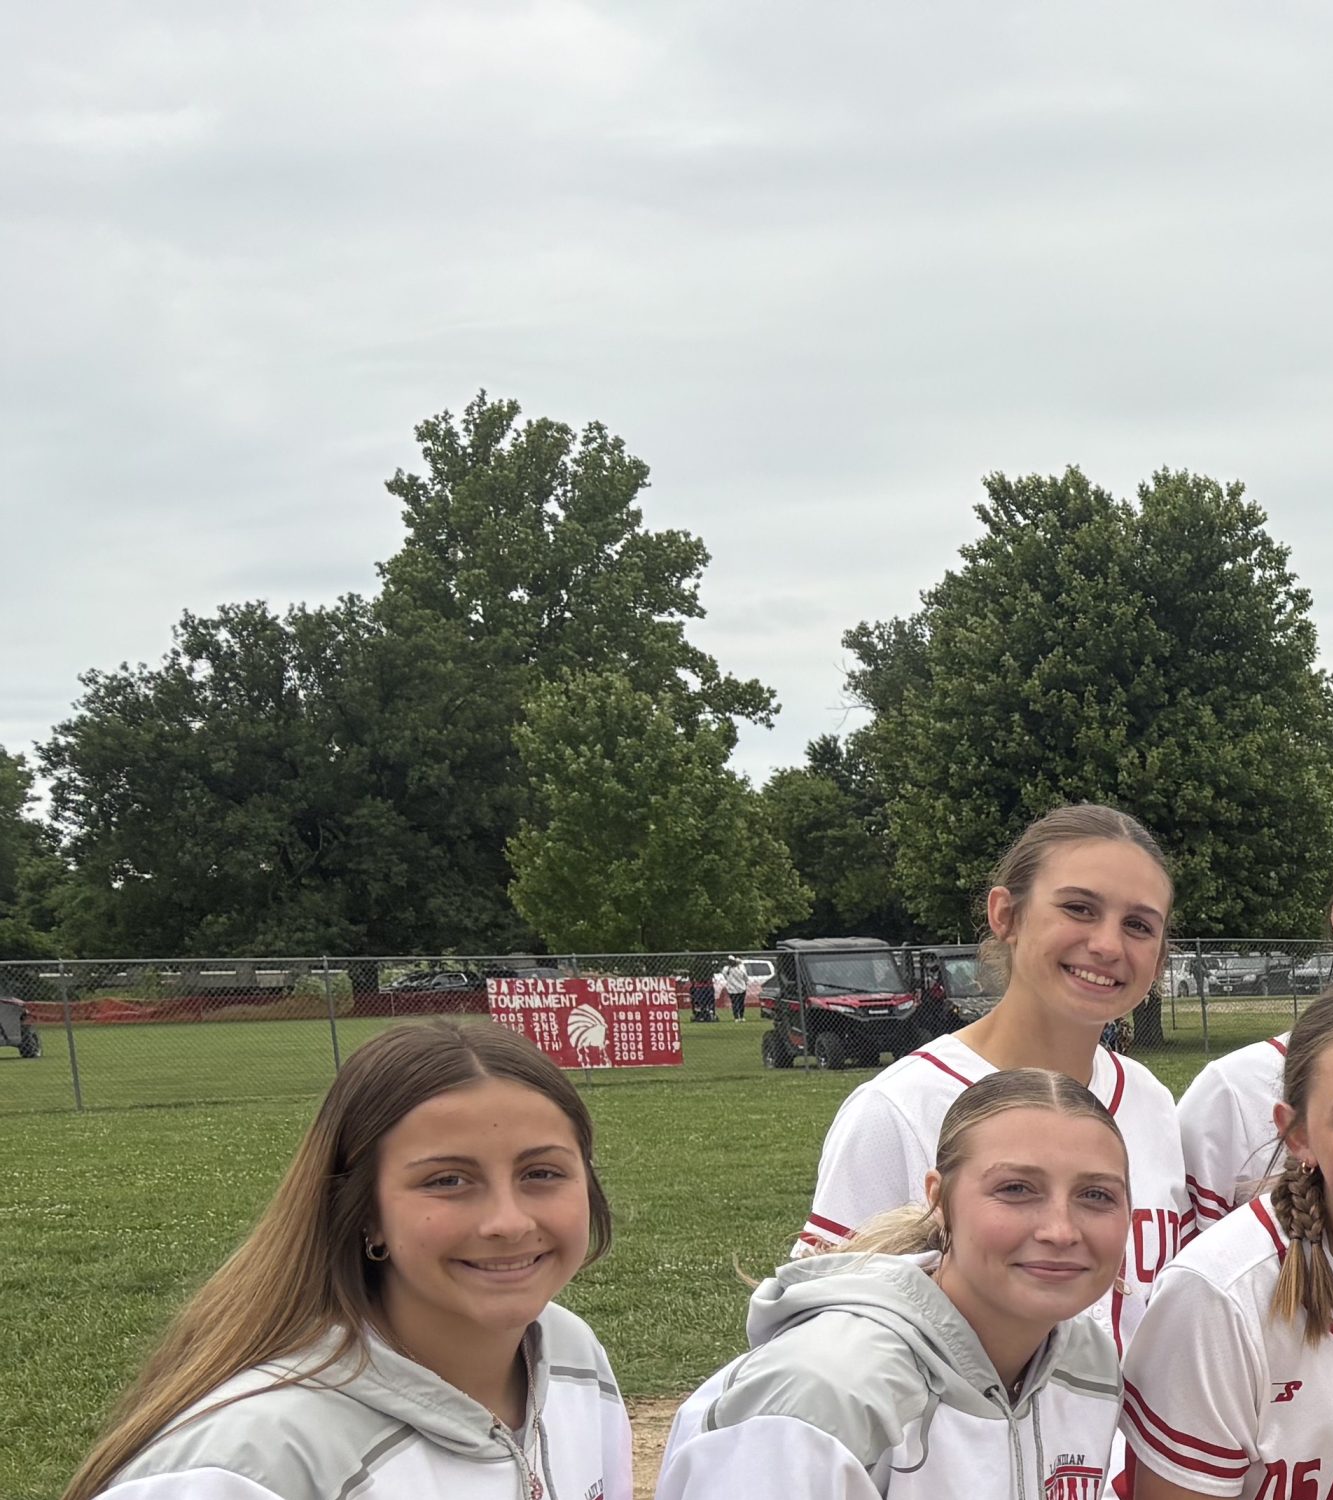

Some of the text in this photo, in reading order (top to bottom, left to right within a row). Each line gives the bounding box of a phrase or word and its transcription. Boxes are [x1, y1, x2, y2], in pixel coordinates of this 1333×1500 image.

[515, 979, 566, 994] STATE
[608, 978, 676, 993] REGIONAL
[489, 994, 578, 1009] TOURNAMENT
[601, 992, 677, 1006] CHAMPIONS
[492, 1012, 556, 1023] 2005 3RD
[649, 1022, 679, 1031] 2010
[650, 1032, 679, 1041] 2011
[1131, 1208, 1180, 1283] CIT
